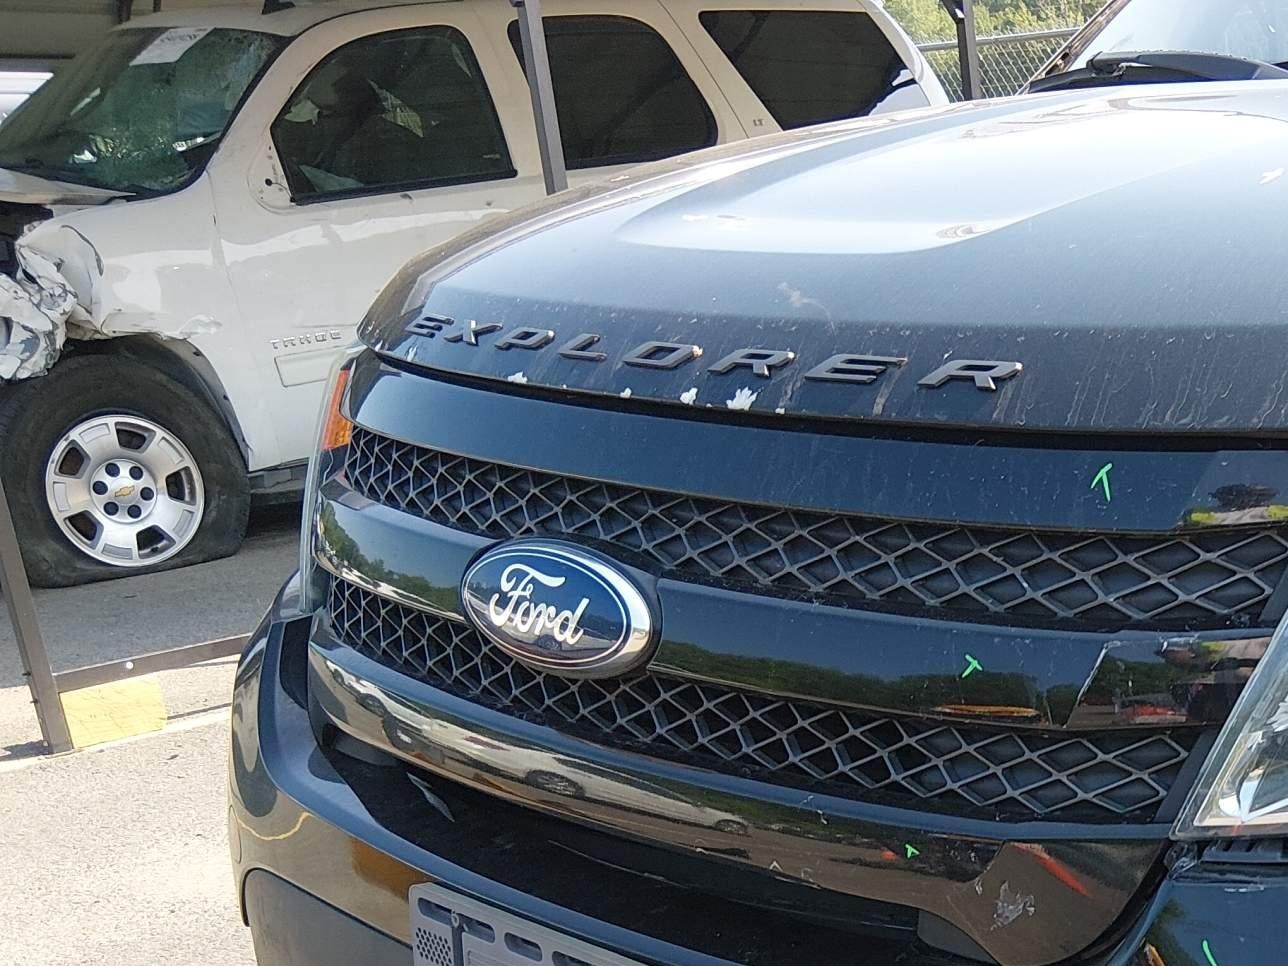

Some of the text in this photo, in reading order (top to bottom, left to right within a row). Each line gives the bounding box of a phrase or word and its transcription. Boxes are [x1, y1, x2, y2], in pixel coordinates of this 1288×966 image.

[270, 329, 342, 350] TAHOE
[405, 312, 1022, 391] EXPLORER
[489, 563, 590, 645] Ford
